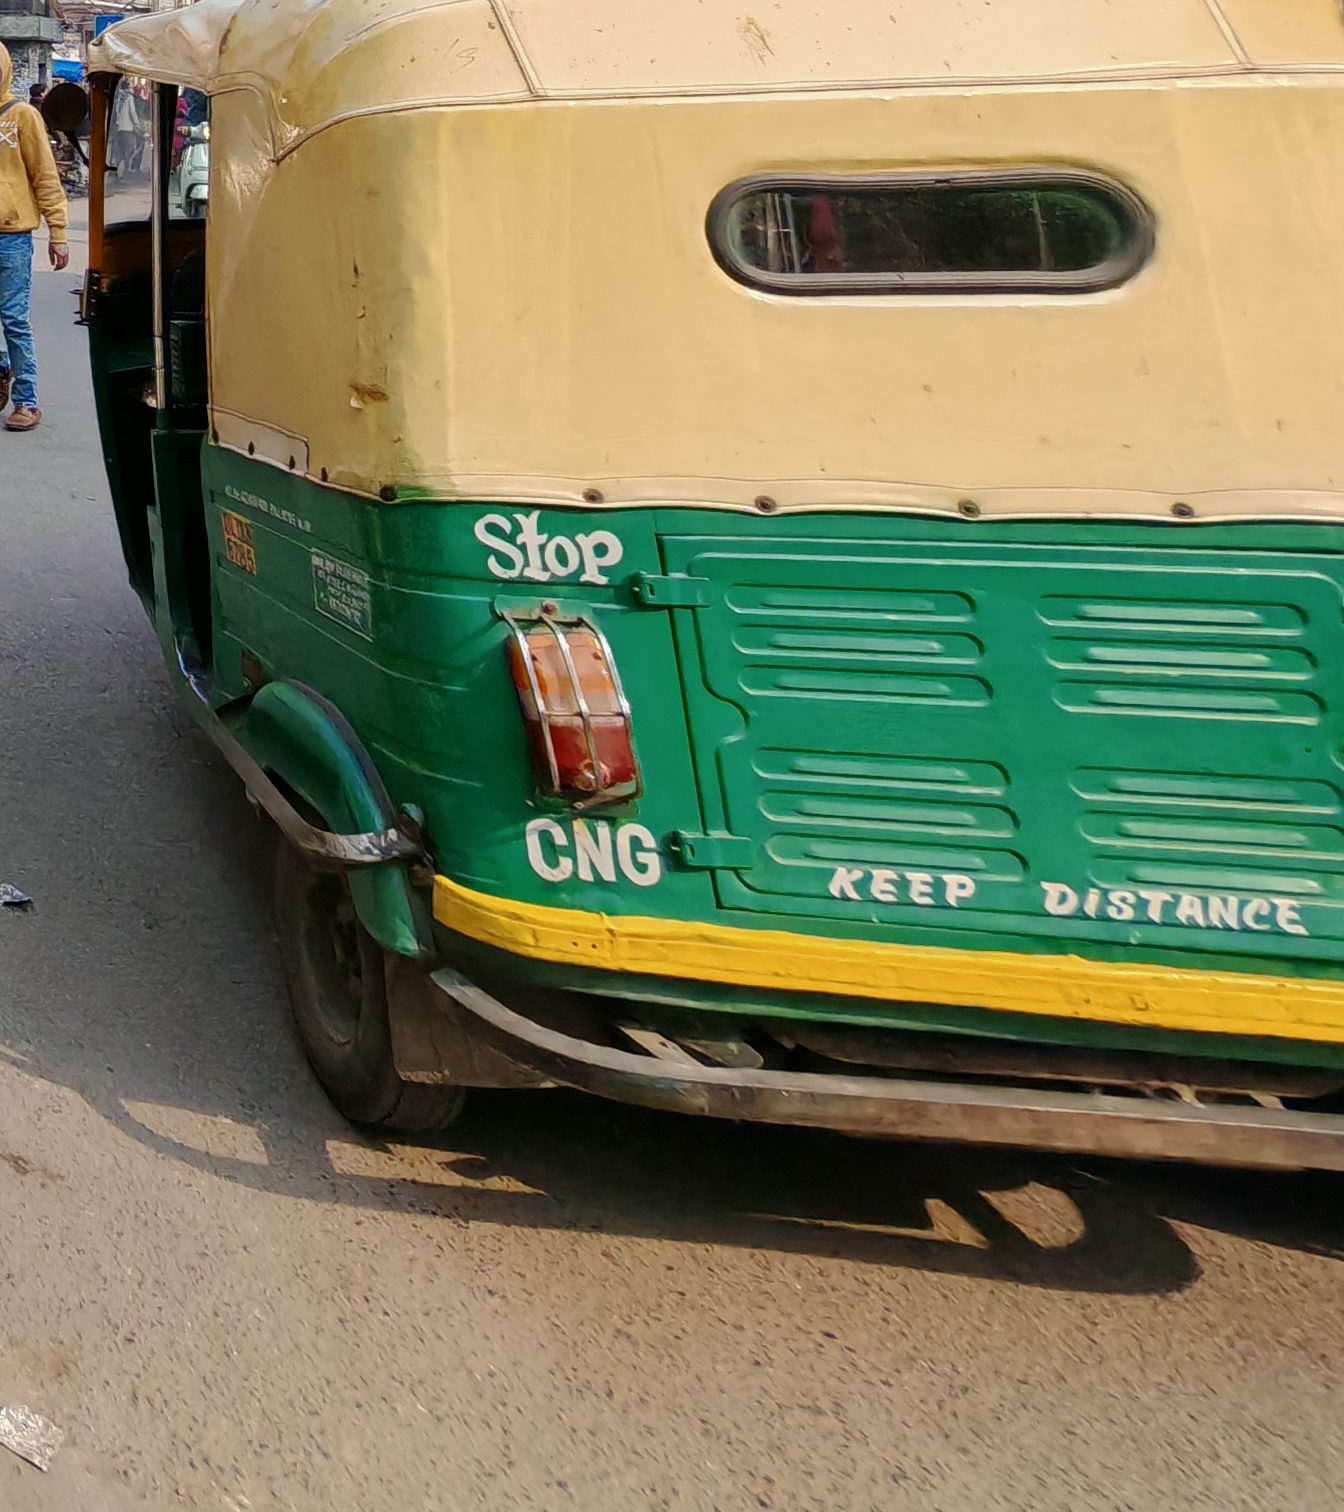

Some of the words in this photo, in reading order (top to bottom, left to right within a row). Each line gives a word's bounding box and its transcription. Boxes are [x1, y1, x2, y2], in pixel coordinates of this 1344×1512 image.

[474, 510, 623, 584] Stop
[525, 818, 661, 887] CNG
[828, 866, 976, 909] KEEP
[1040, 880, 1310, 936] DISTANCE
